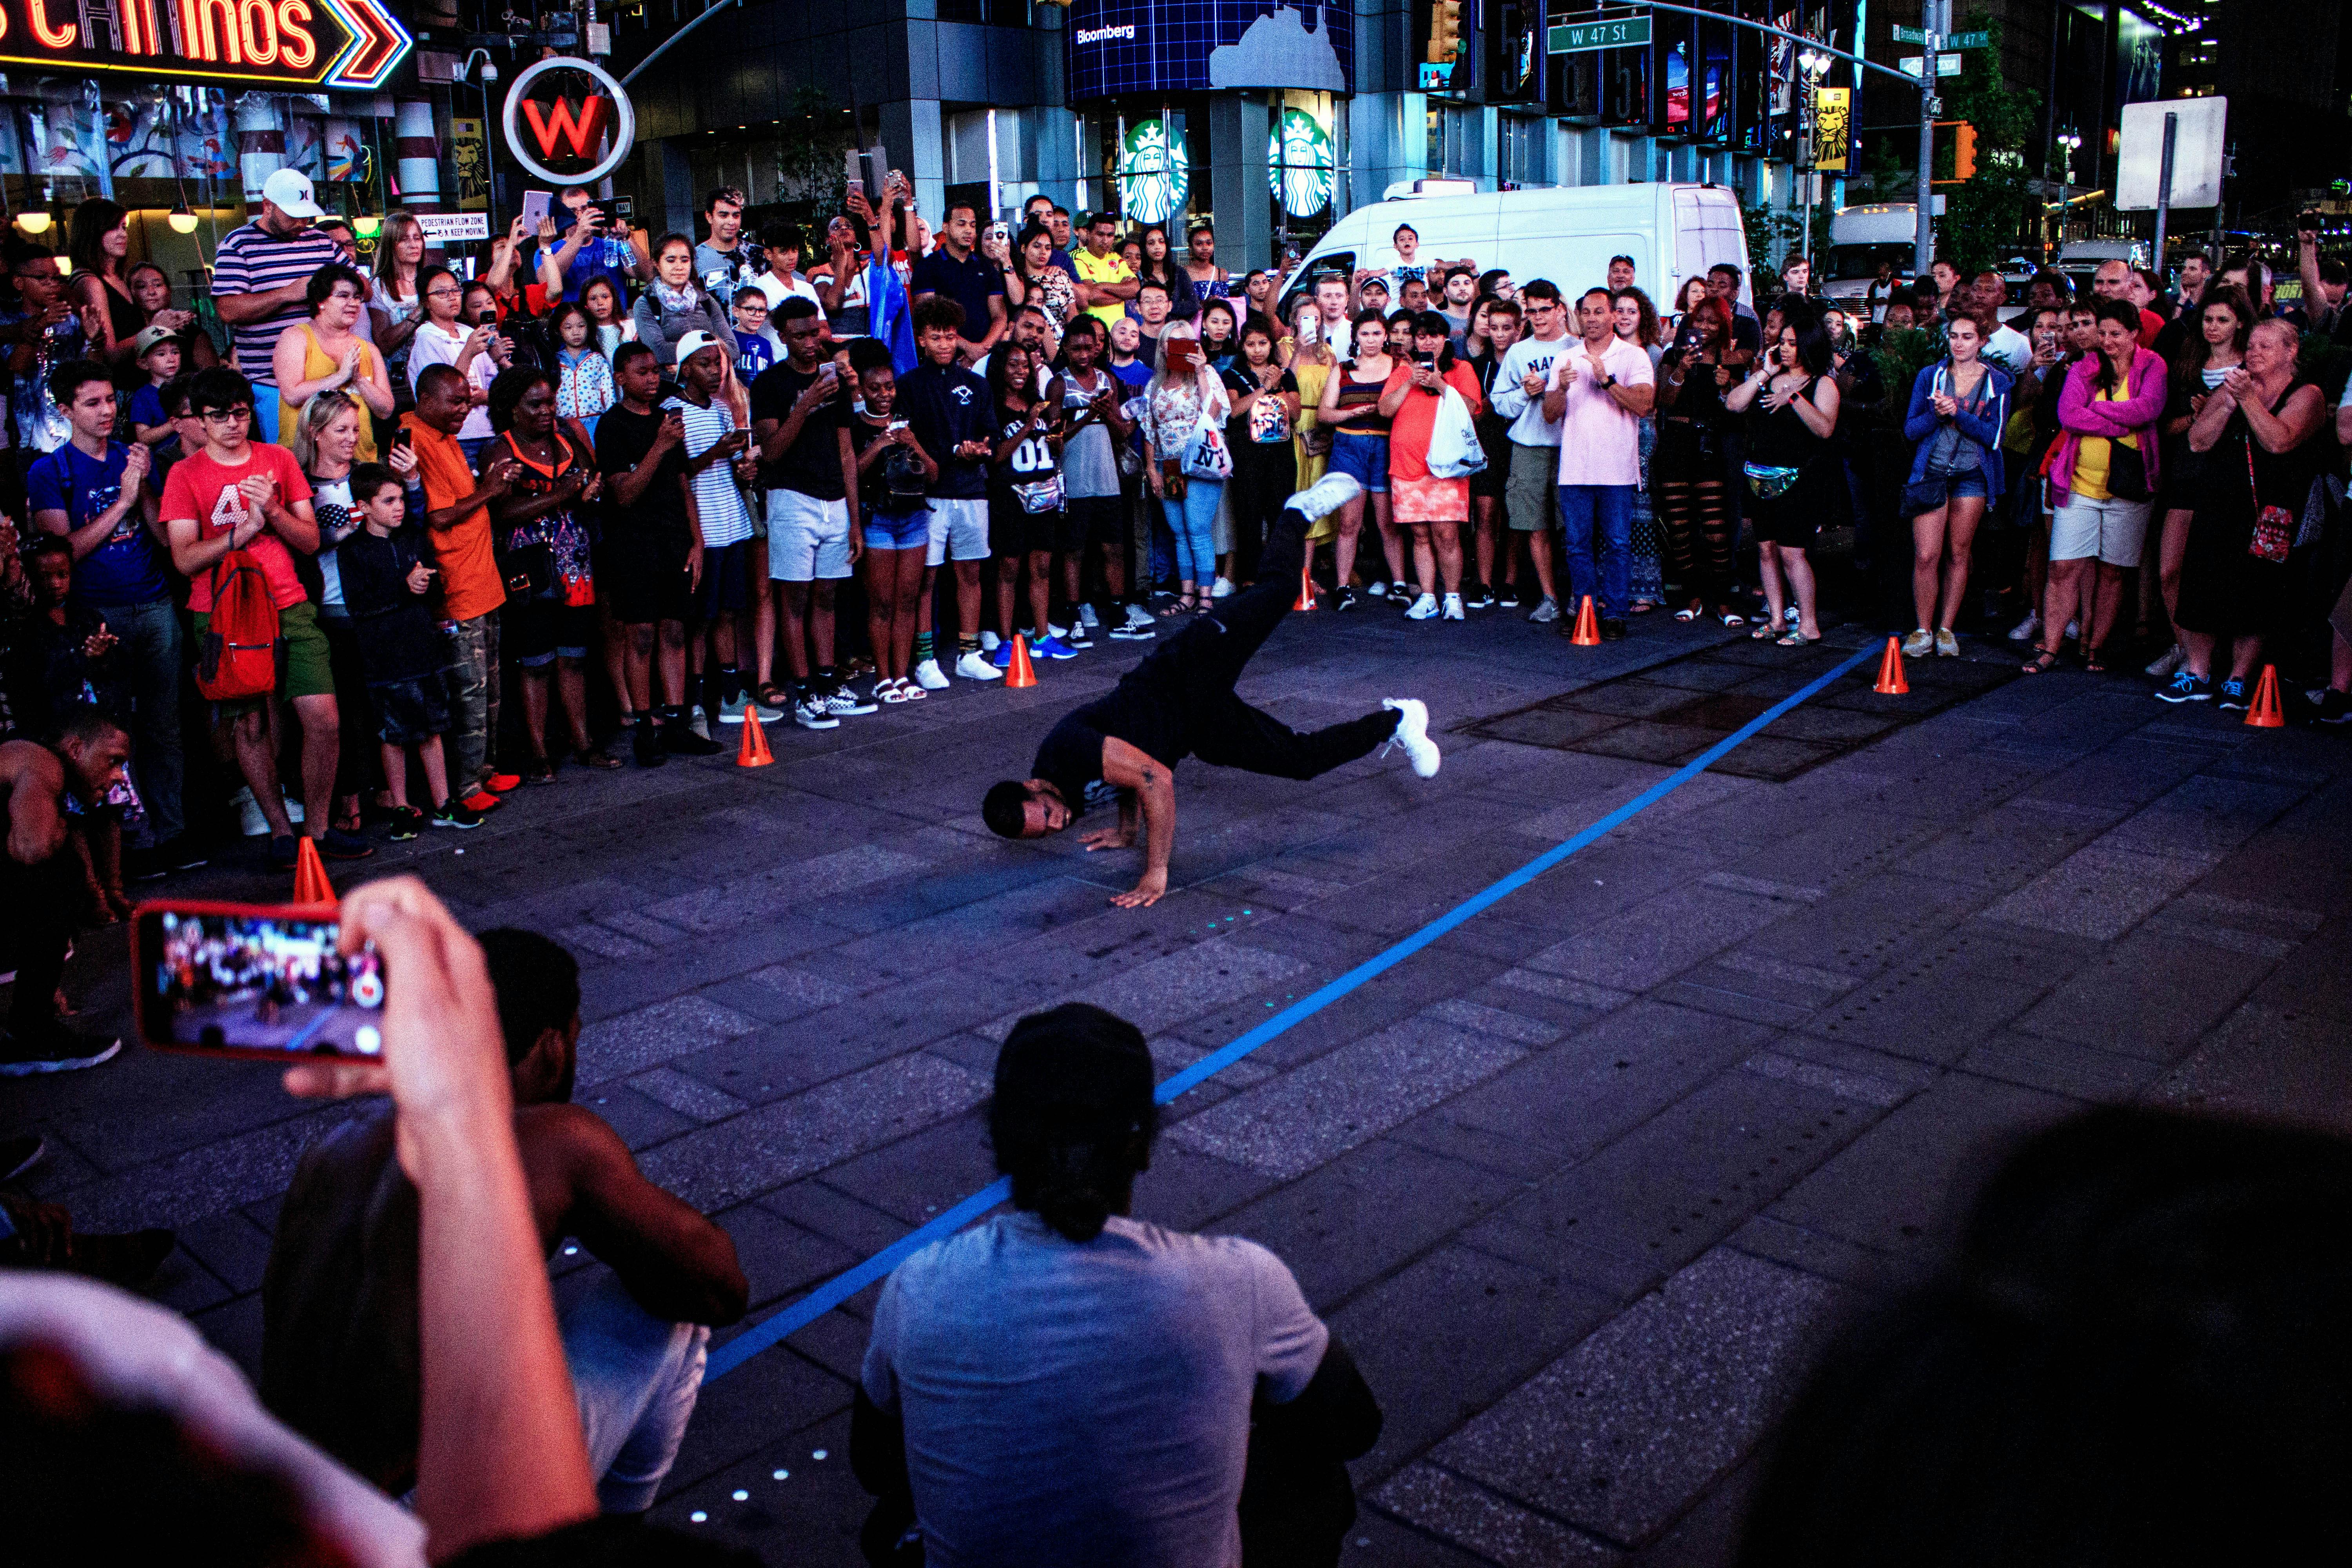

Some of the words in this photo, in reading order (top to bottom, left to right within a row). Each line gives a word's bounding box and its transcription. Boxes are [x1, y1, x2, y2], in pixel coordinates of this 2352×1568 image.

[1077, 24, 1134, 44] Bloomberg
[1572, 30, 1583, 44] W
[1590, 27, 1606, 43] 47
[1613, 24, 1626, 41] St
[1900, 27, 1924, 44] Broadway
[1950, 35, 1959, 47] W
[1964, 34, 1976, 47] 47
[522, 95, 612, 161] W
[421, 218, 454, 227] PEDESTRIAN
[455, 218, 469, 226] FLOW
[471, 217, 484, 225] ZONE
[465, 227, 486, 236] MOVING
[1202, 428, 1212, 448] I
[1193, 445, 1225, 469] NY
[210, 483, 249, 527] 4
